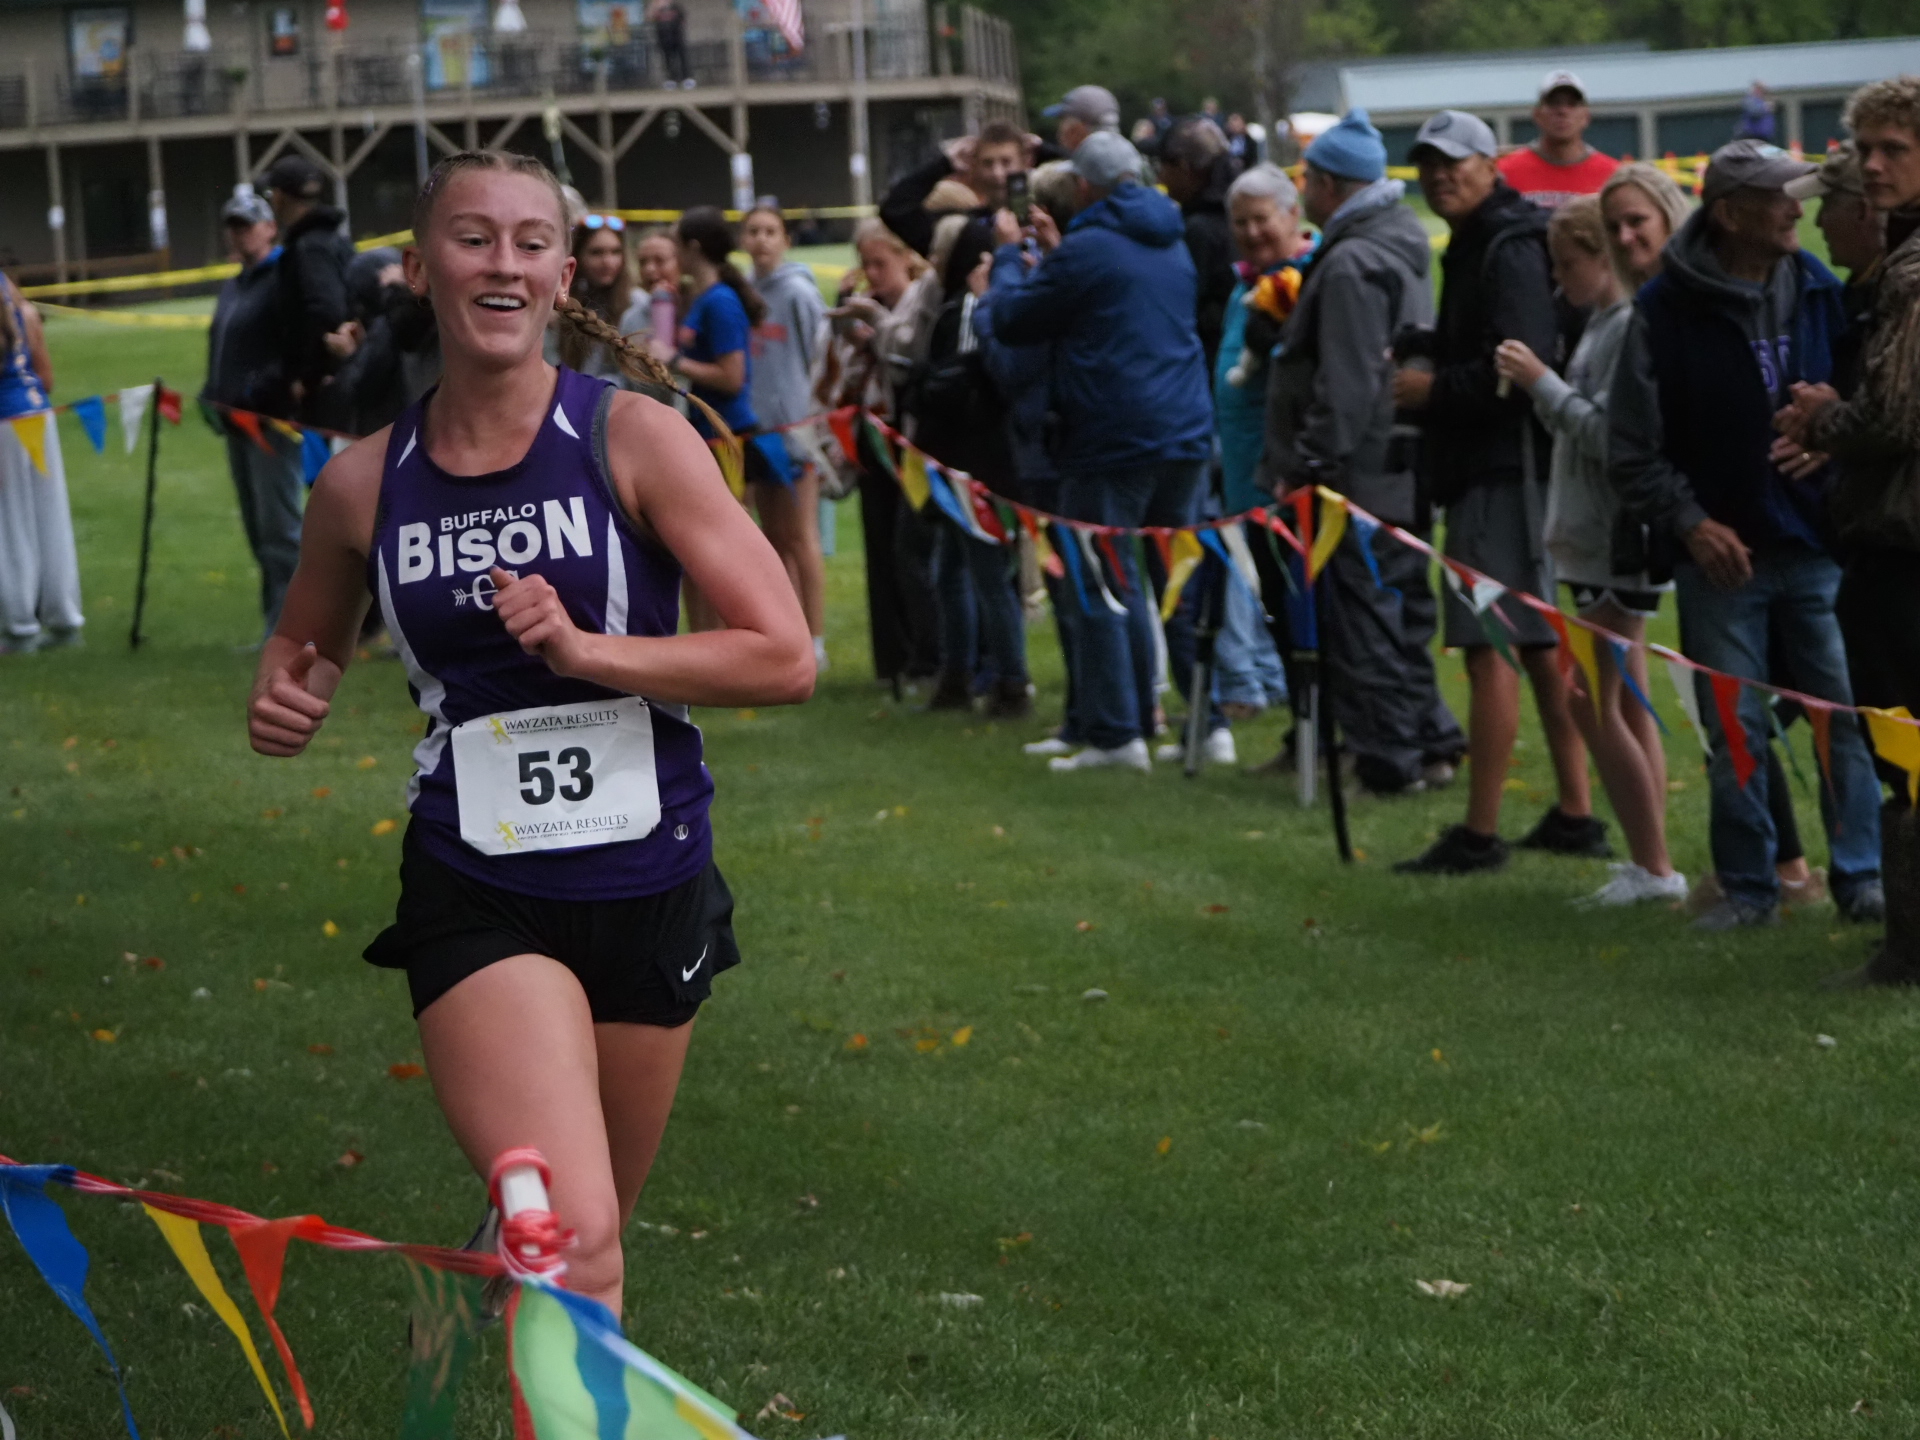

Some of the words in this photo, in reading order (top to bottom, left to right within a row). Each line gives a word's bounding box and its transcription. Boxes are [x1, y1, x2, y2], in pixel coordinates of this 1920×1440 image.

[440, 503, 536, 532] BUFFALO
[398, 496, 593, 585] BISON
[504, 716, 563, 730] WAYZATA
[567, 709, 619, 725] RESULTS
[518, 746, 594, 805] 53
[514, 821, 573, 835] WAYZATA
[576, 814, 629, 830] RESULTS
